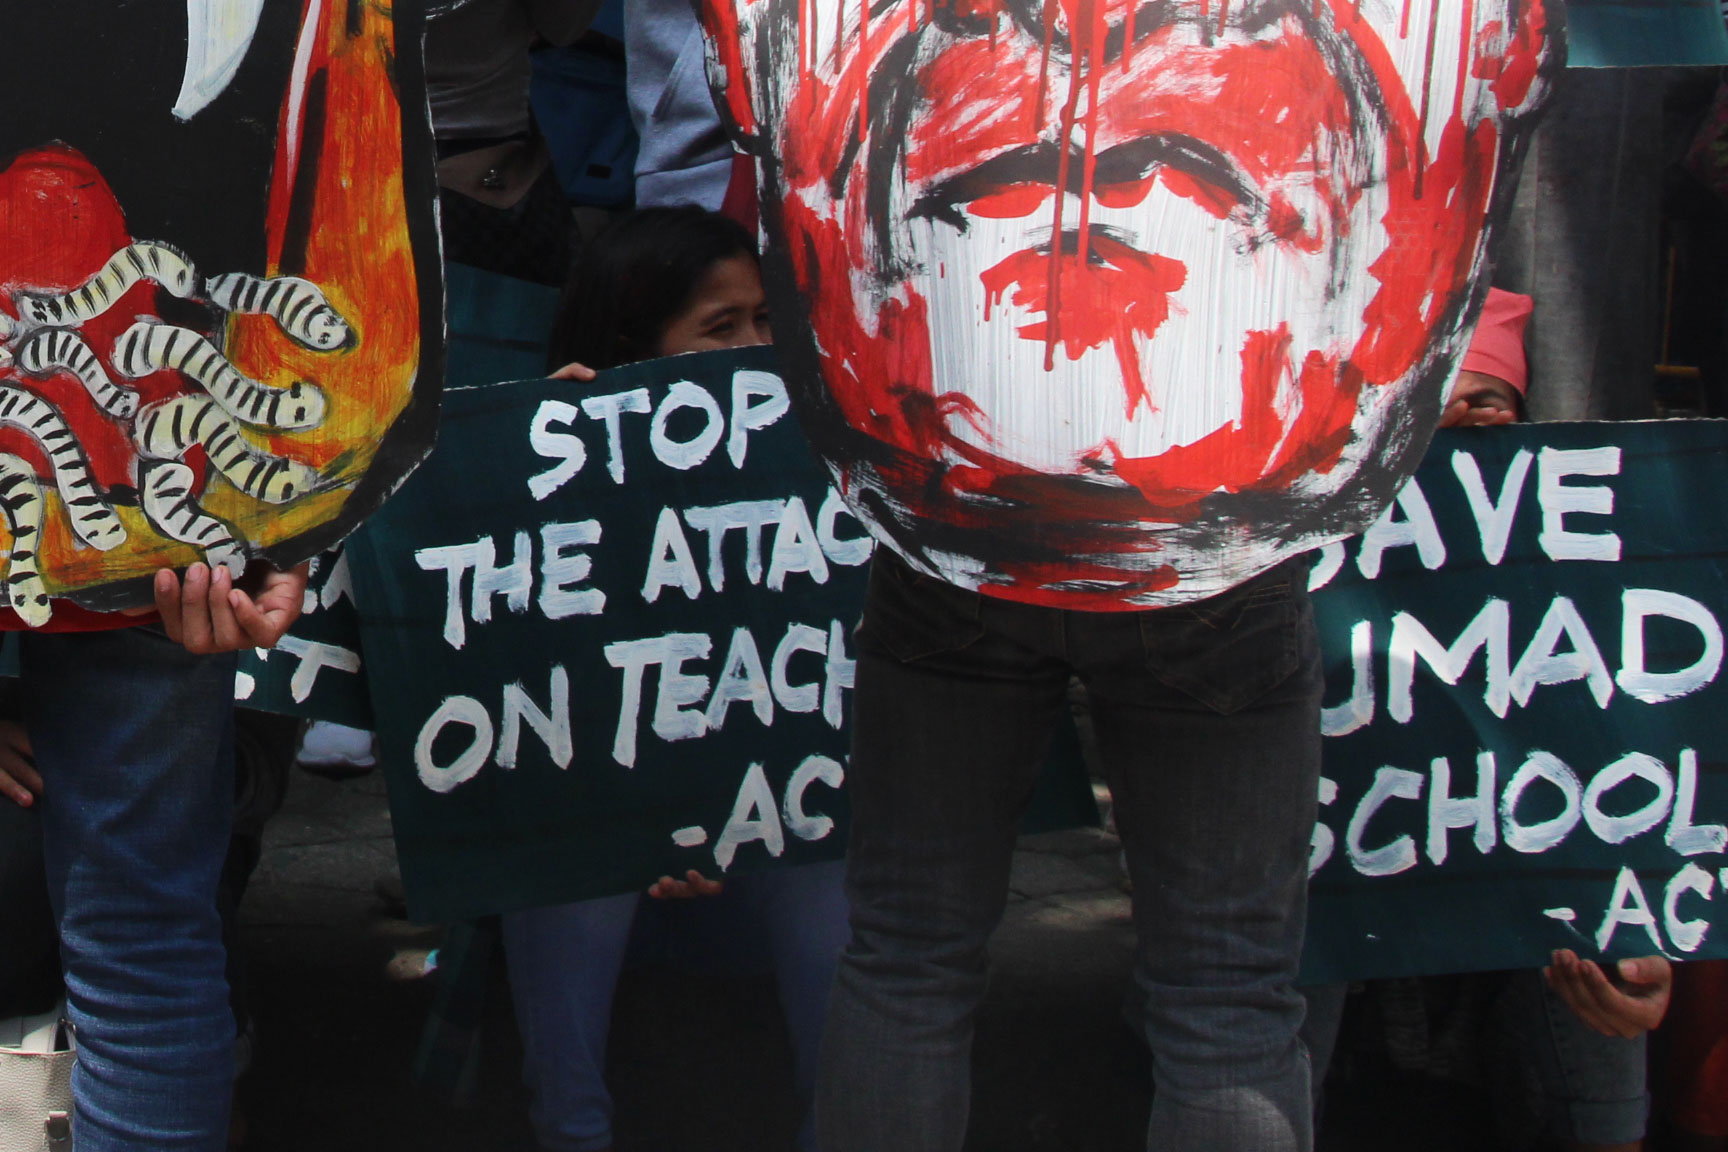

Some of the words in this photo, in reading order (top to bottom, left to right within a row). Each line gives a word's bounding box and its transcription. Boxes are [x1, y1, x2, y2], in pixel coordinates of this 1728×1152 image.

[526, 369, 792, 501] STOP
[415, 519, 607, 649] THE
[413, 662, 573, 793] ON
[671, 753, 849, 873] -AC
[1543, 861, 1728, 961] -AC
